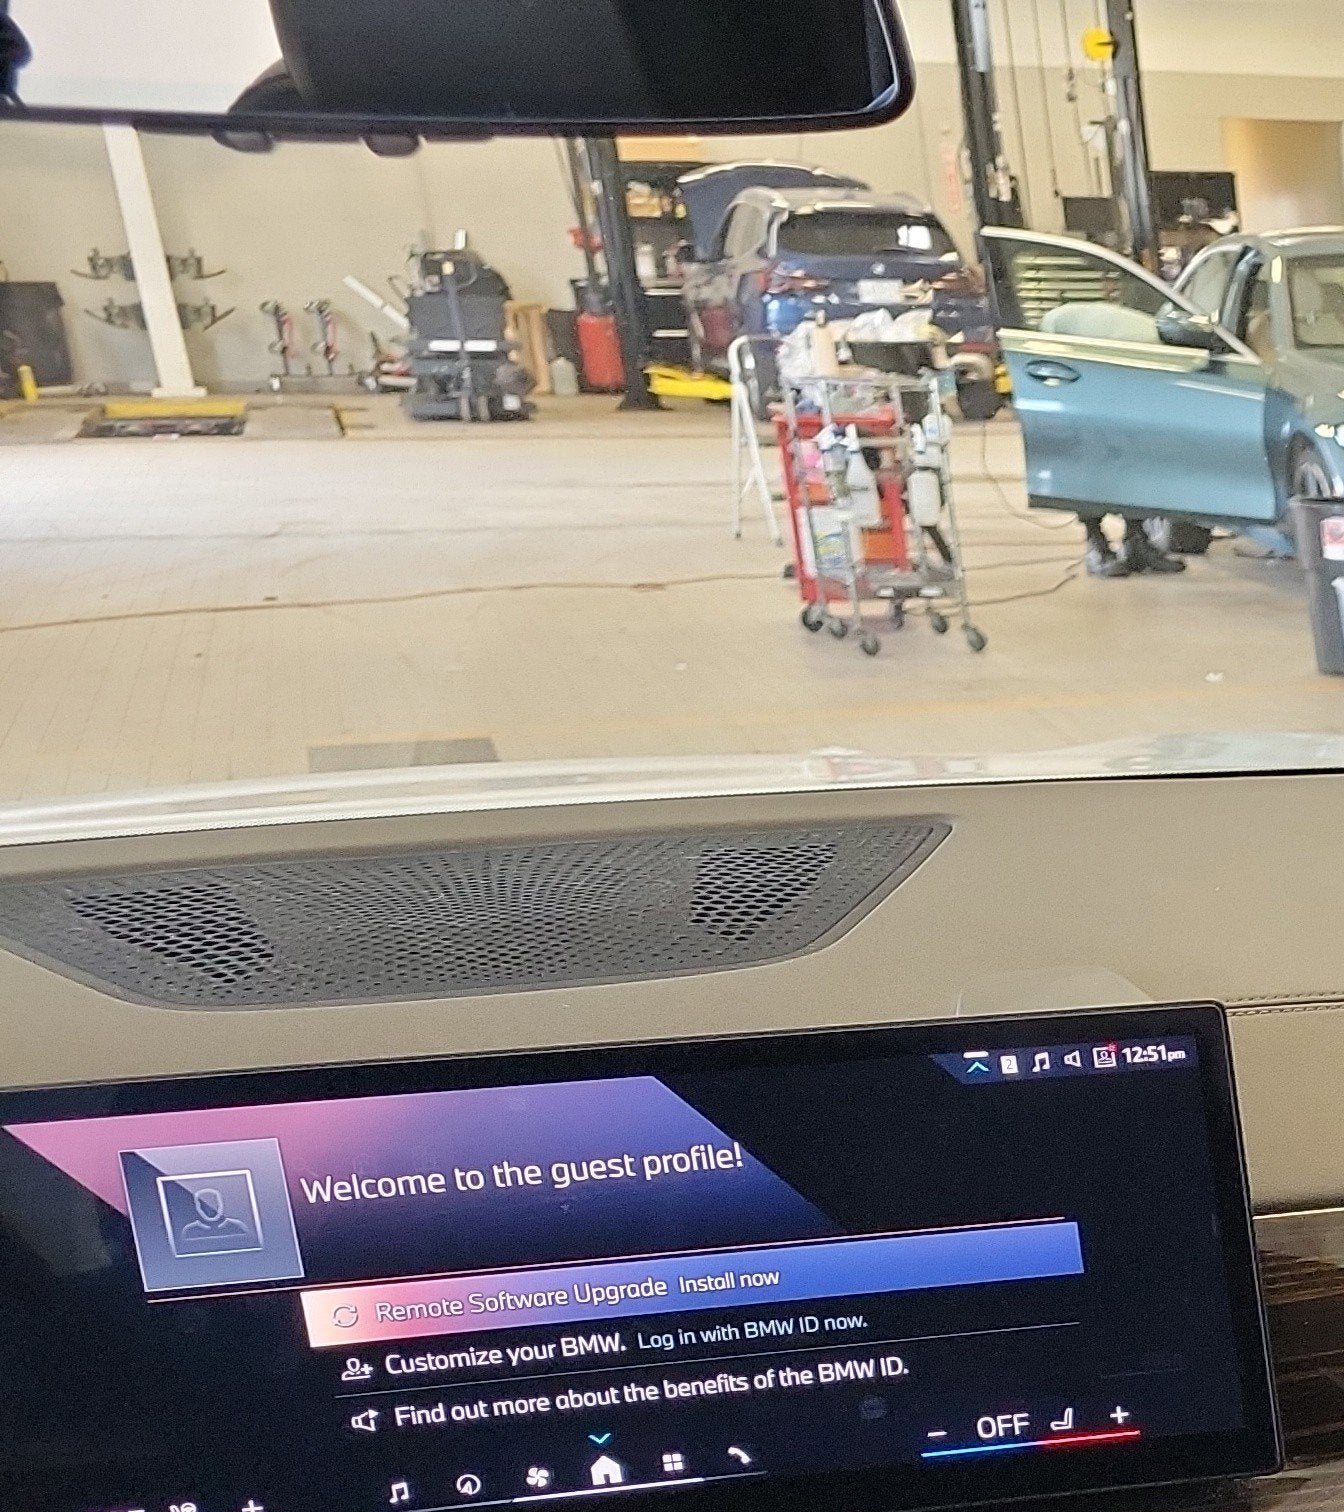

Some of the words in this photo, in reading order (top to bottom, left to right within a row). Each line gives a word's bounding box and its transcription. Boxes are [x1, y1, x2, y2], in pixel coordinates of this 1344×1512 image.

[300, 1173, 447, 1204] Welcome
[453, 1167, 485, 1191] to
[492, 1160, 543, 1188] the
[551, 1153, 637, 1189] guest
[642, 1141, 744, 1181] profile!
[375, 1299, 464, 1322] Remote
[468, 1290, 569, 1314] Software
[573, 1277, 668, 1306] Upgrade
[679, 1271, 736, 1294] Install
[739, 1271, 780, 1288] now
[385, 1346, 502, 1375] Customize
[506, 1342, 557, 1367] your
[560, 1332, 627, 1357] BMW.
[637, 1332, 675, 1350] Log
[678, 1328, 697, 1345] in
[700, 1323, 741, 1343] with
[743, 1317, 795, 1339] BMW
[798, 1315, 820, 1334] ID
[824, 1315, 869, 1332] now.
[394, 1402, 447, 1427] Find
[451, 1401, 490, 1422] out
[492, 1395, 551, 1415] more
[555, 1387, 621, 1411] about
[623, 1383, 660, 1402] the
[663, 1373, 750, 1399] benefits
[753, 1368, 777, 1390] of
[778, 1366, 814, 1387] the
[817, 1358, 875, 1383] BMW
[879, 1356, 910, 1377] ID.
[976, 1413, 1031, 1440] OFF
